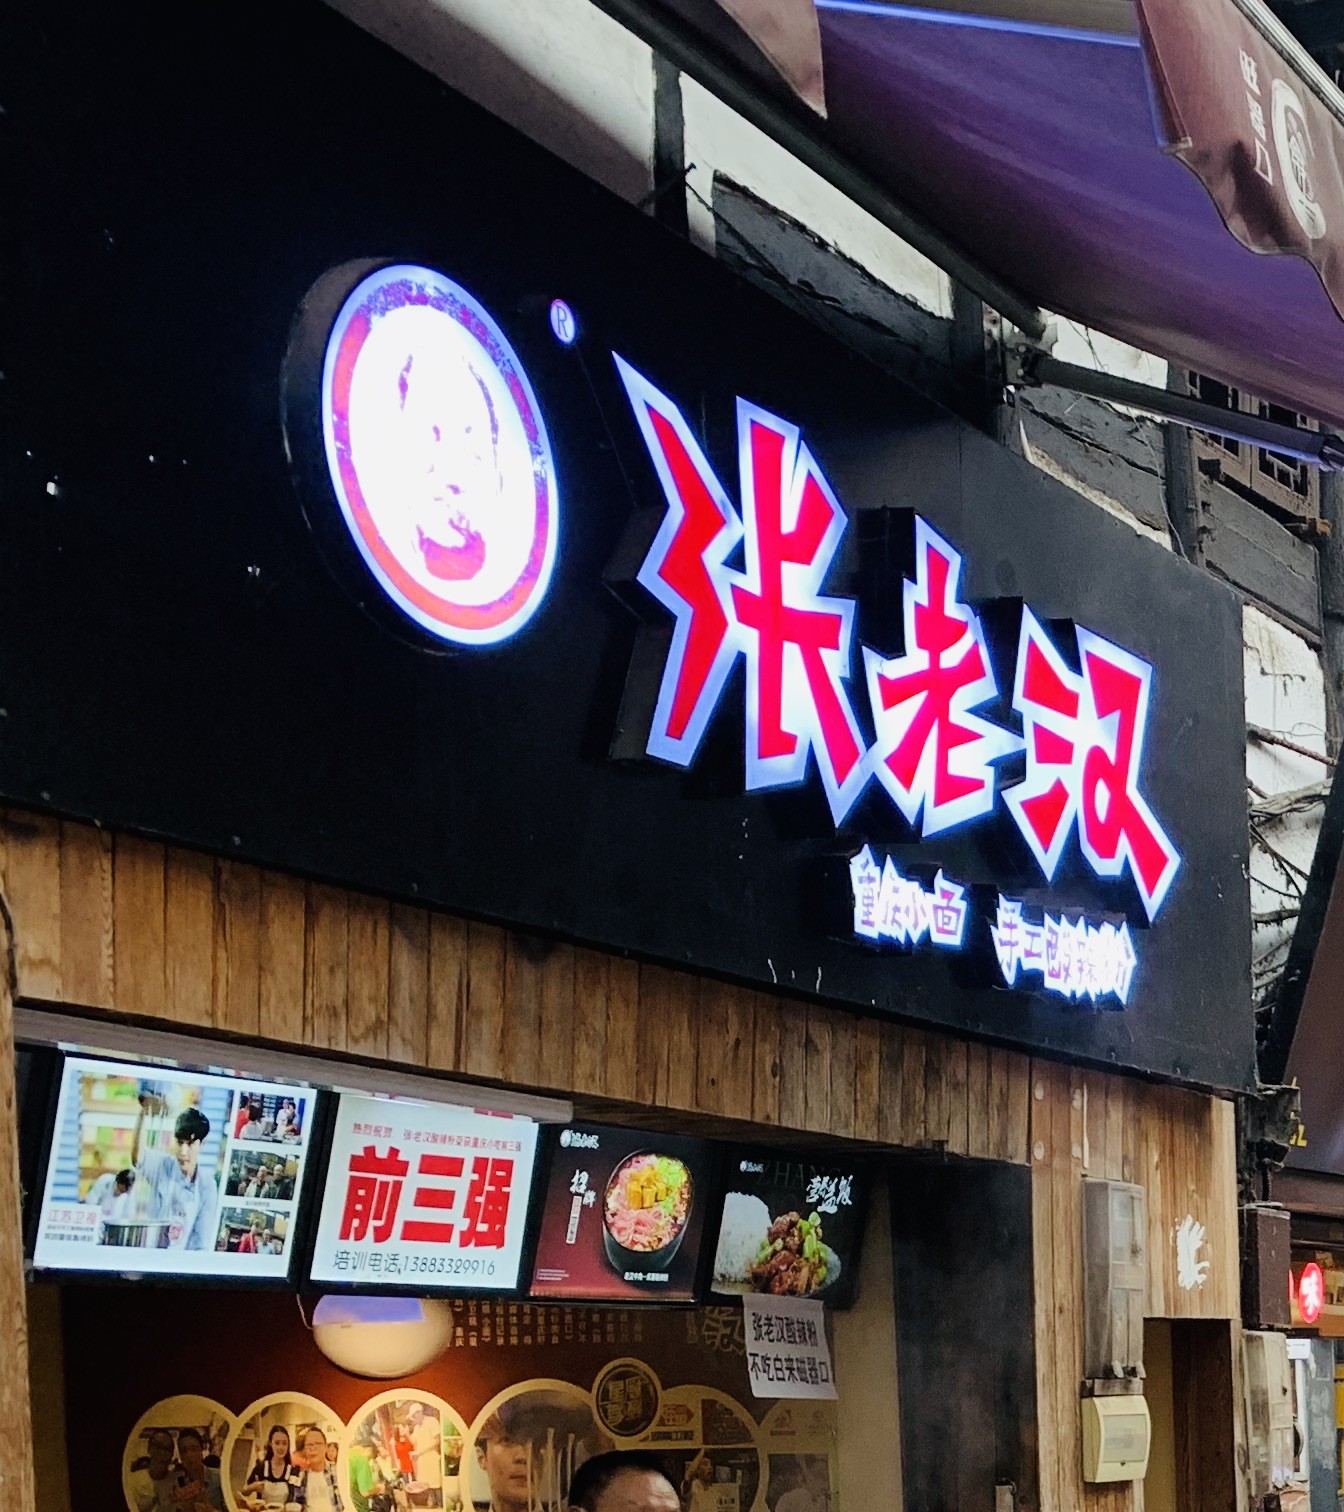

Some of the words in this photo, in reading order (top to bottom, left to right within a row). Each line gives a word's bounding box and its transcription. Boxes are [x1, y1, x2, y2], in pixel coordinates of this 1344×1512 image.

[612, 352, 1181, 921] 张老汉
[338, 1144, 514, 1249] 前三强
[333, 1249, 400, 1274] 培训电话
[749, 1352, 829, 1385] 不吃白来磁器口
